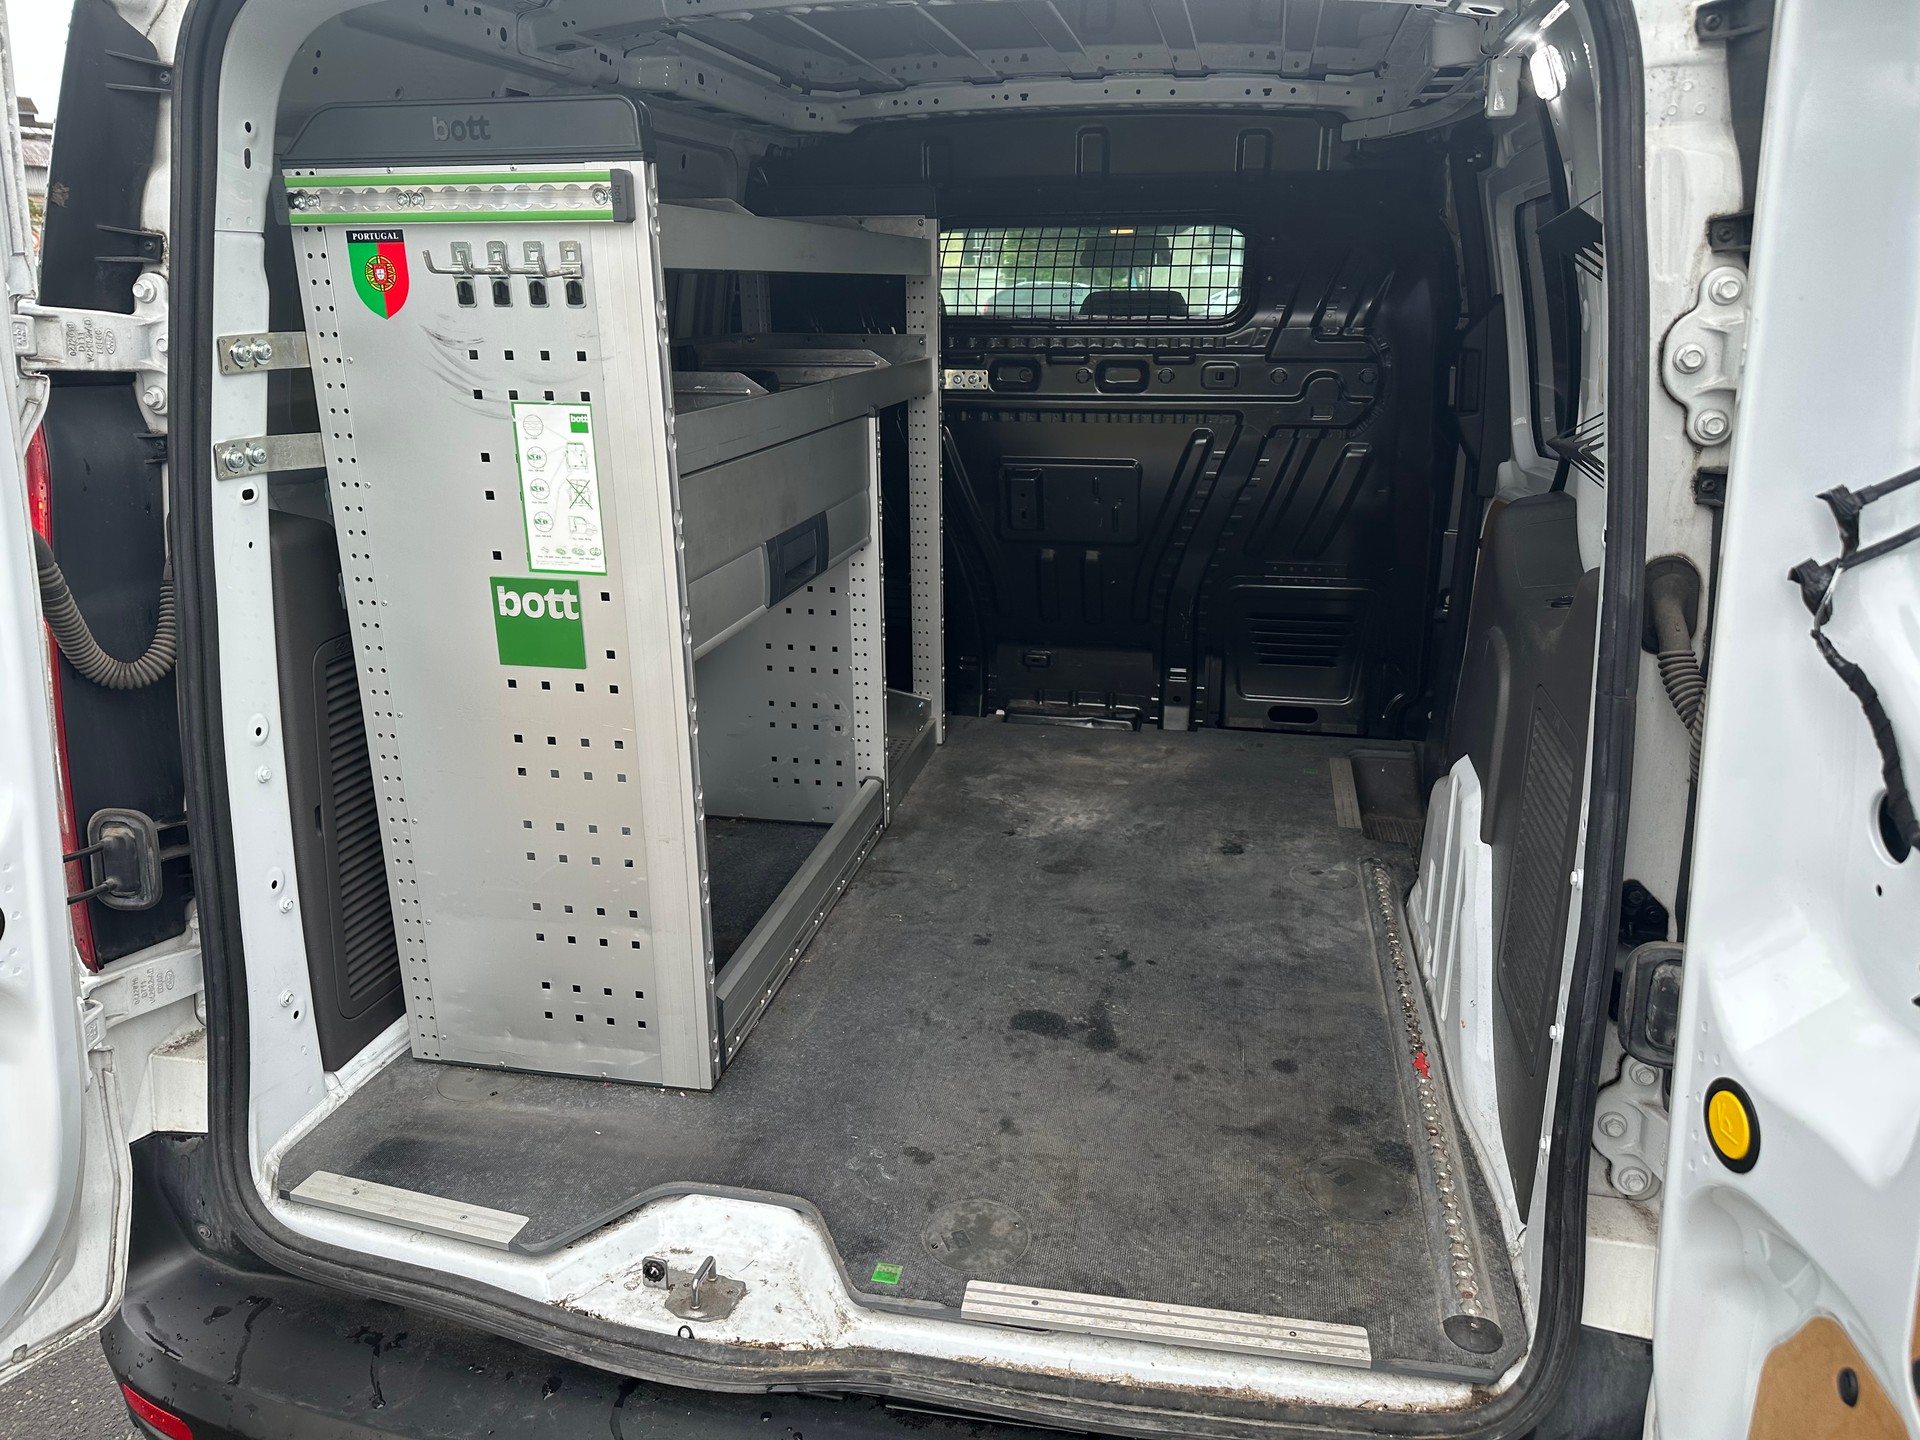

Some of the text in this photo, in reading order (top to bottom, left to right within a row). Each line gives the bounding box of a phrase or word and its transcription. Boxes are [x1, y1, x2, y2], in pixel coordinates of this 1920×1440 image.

[432, 115, 491, 142] bott
[352, 232, 399, 240] PORTUGAL
[570, 415, 588, 423] bott
[497, 585, 579, 620] bott
